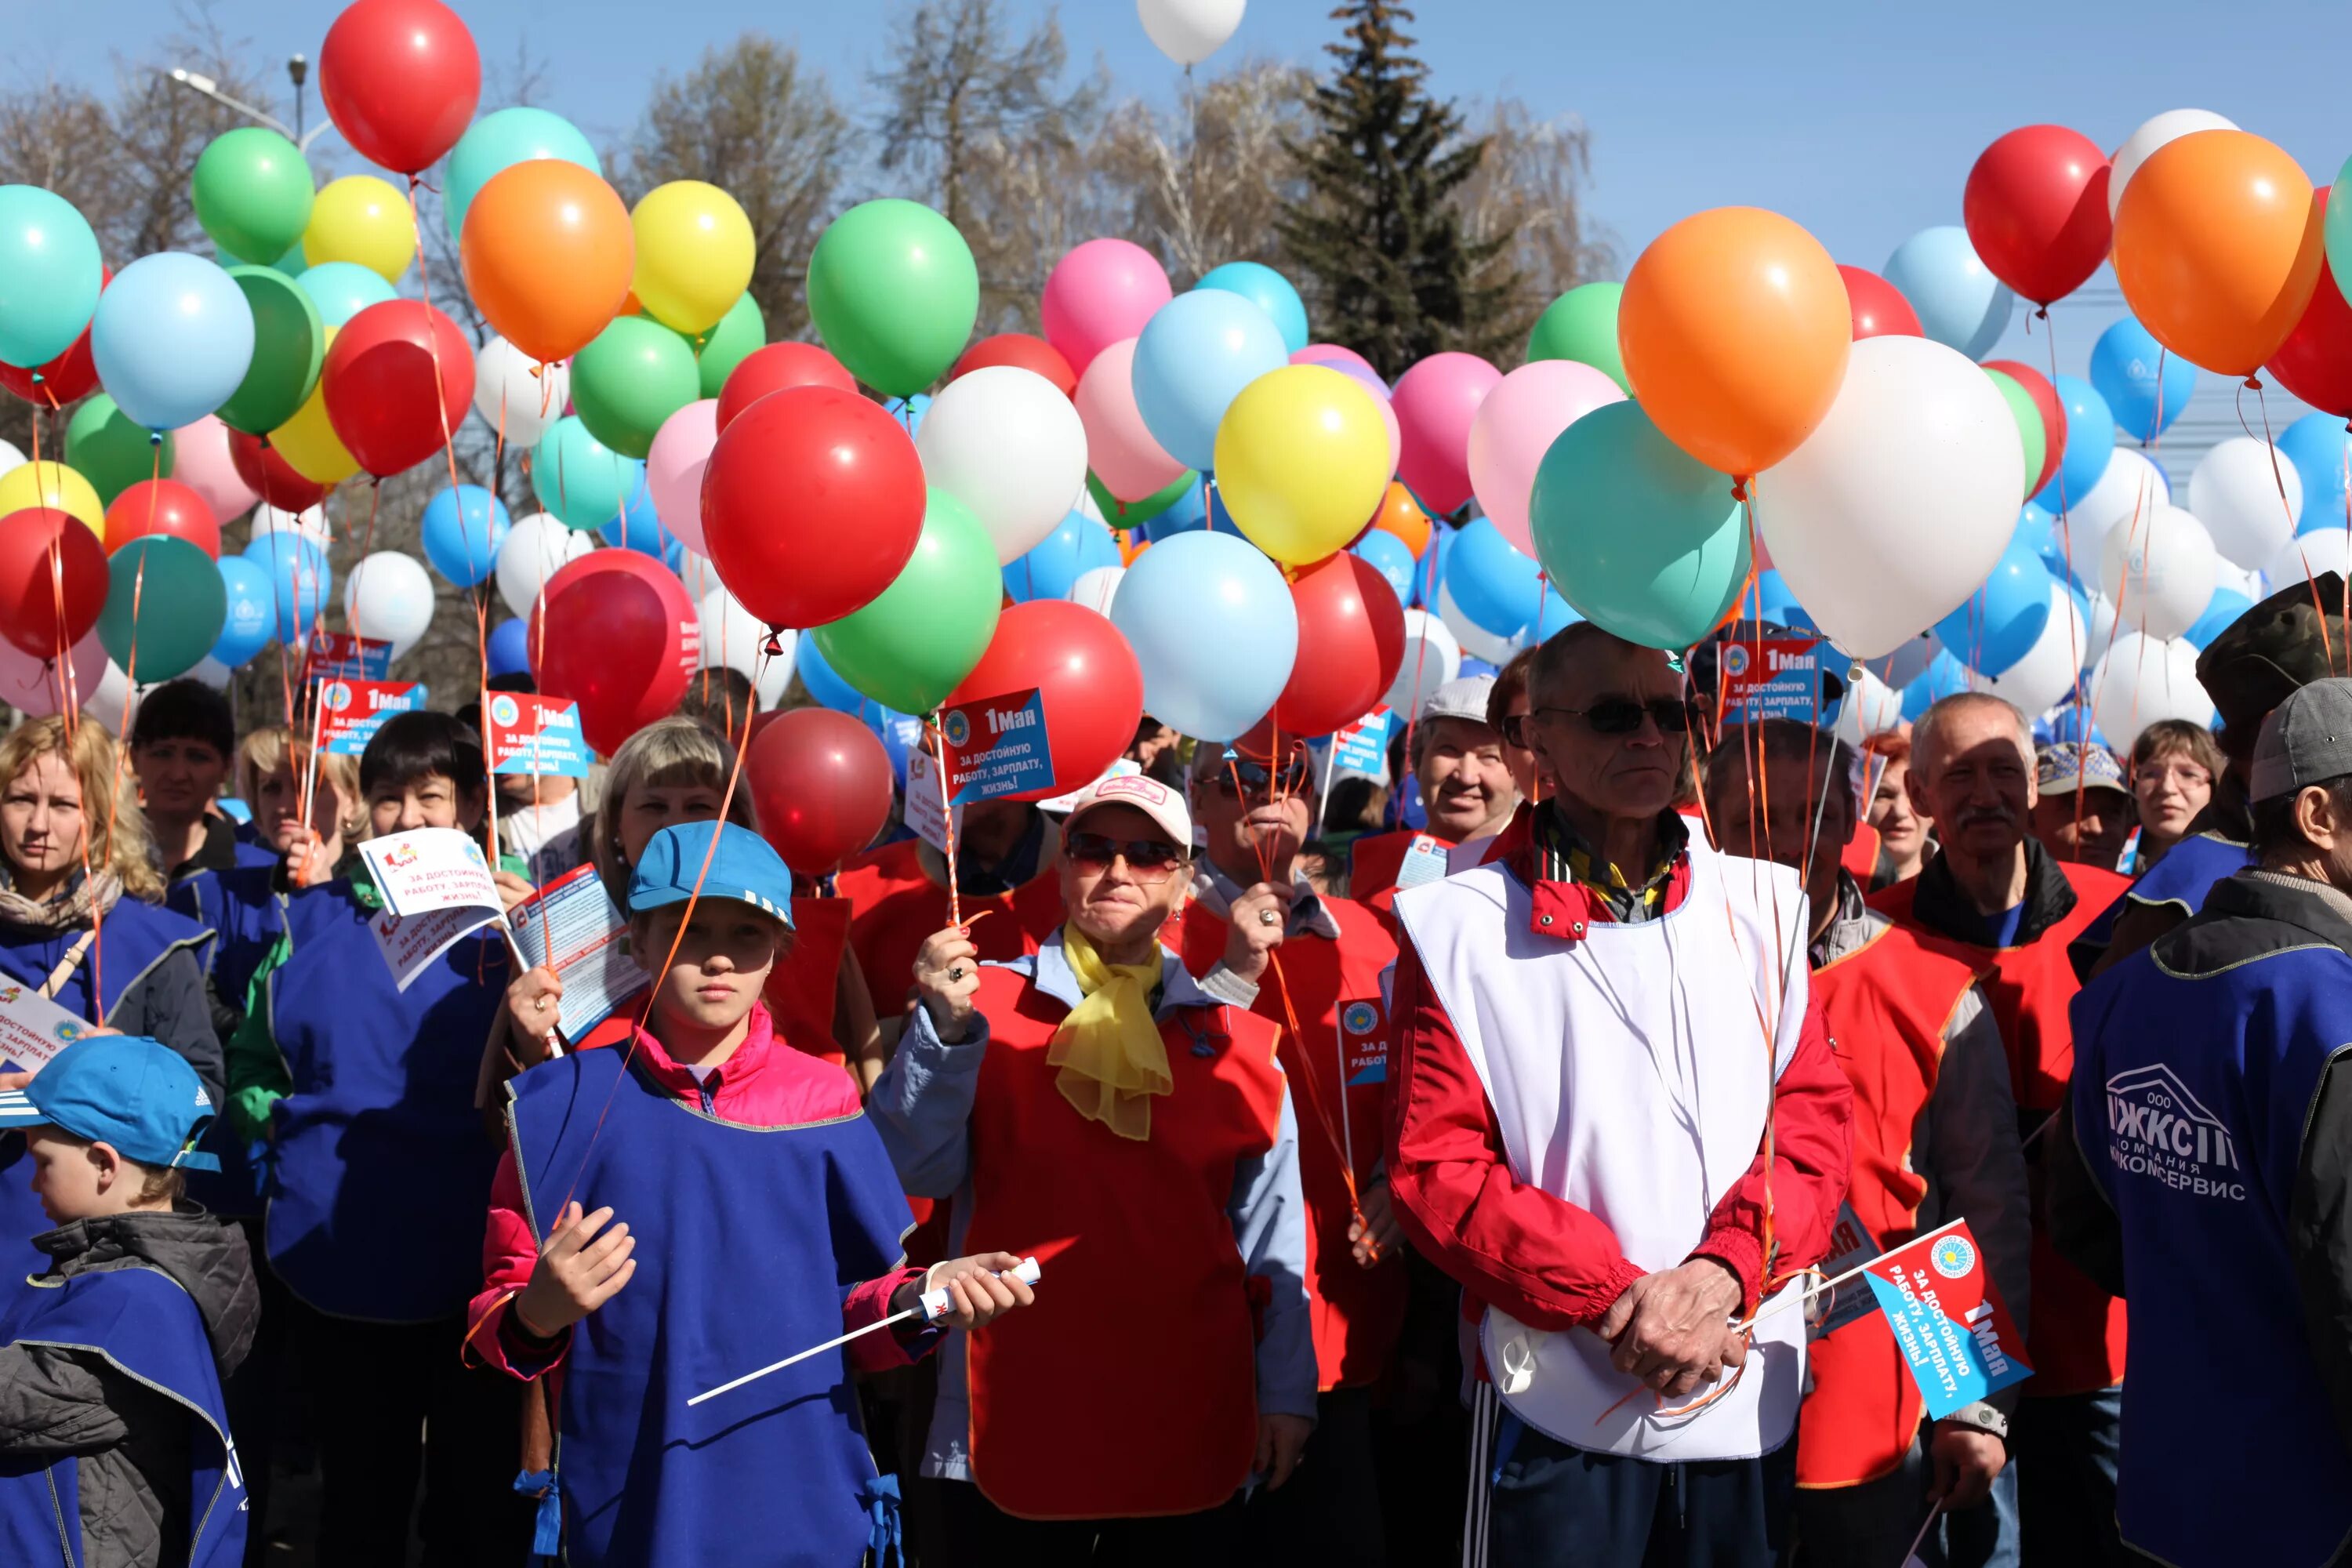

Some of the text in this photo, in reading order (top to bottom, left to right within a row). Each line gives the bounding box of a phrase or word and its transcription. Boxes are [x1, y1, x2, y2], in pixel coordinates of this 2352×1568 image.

[985, 708, 1036, 735] 1Мая
[960, 742, 1031, 767] ЗА ДОСТОЙНУЮ
[953, 758, 1044, 785] РАБОТУ, ЗАРПЛАТУ,
[981, 775, 1018, 796] ЖИЗНЬ!
[1361, 1042, 1376, 1052] ЗА
[1889, 1265, 1958, 1399] РАБОТУ, ЗАРПЛАТУ,
[1912, 1269, 1970, 1377] ЗА ДОСТОЙНУЮ
[1892, 1310, 1930, 1367] ЖИЗНЬ!
[1964, 1298, 2009, 1377] 1Мая
